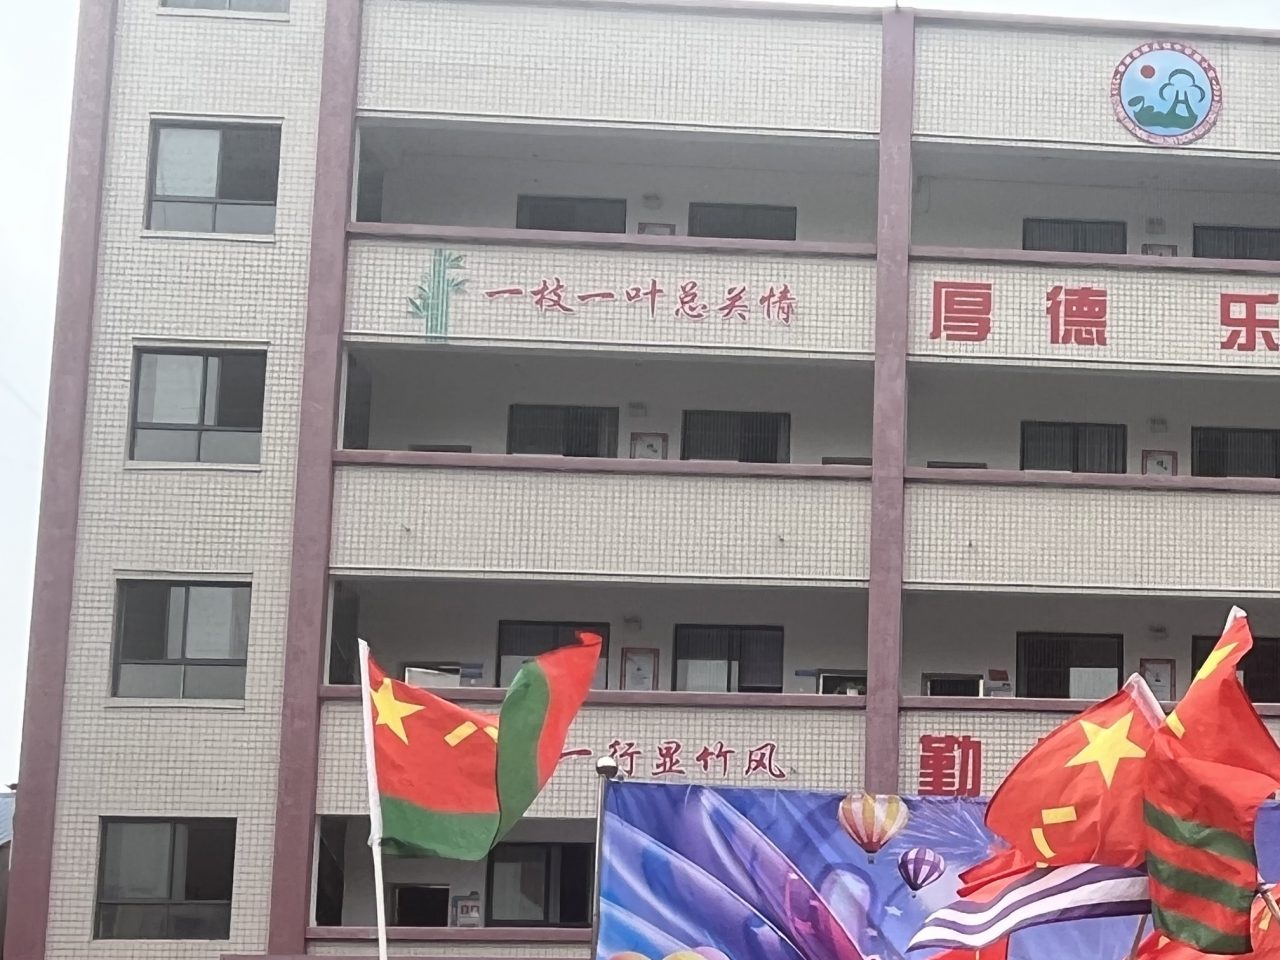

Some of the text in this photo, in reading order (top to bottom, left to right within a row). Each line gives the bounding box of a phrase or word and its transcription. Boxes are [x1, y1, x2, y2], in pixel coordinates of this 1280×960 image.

[484, 277, 798, 326] 一枝一叶总关情
[929, 280, 1108, 347] 厚德
